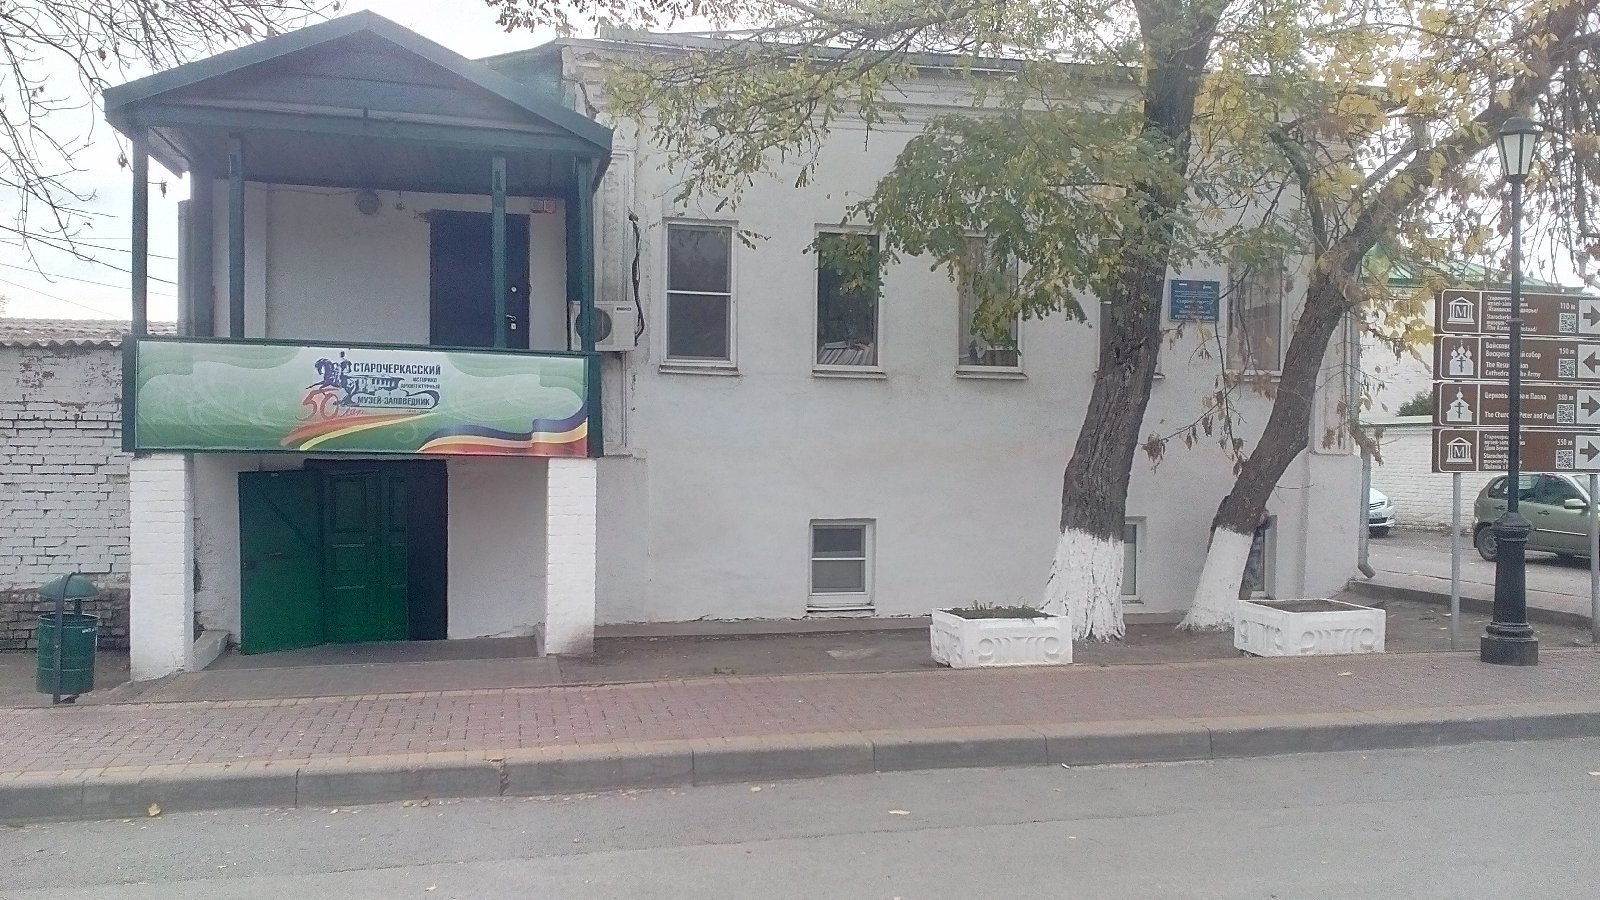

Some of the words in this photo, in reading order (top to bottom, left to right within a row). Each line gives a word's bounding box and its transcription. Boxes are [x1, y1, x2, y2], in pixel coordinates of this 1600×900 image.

[1560, 302, 1570, 310] 110
[1525, 350, 1542, 360] собор
[354, 362, 441, 375] СТАРОЧЕРКАССКИЙ
[1485, 361, 1495, 369] The
[1527, 371, 1542, 379] Army
[357, 395, 430, 406] МУЗЕЙ-ЗАПОВЕДНИК
[295, 388, 339, 422] 50
[1543, 412, 1555, 420] Paul
[1557, 438, 1567, 446] 550
